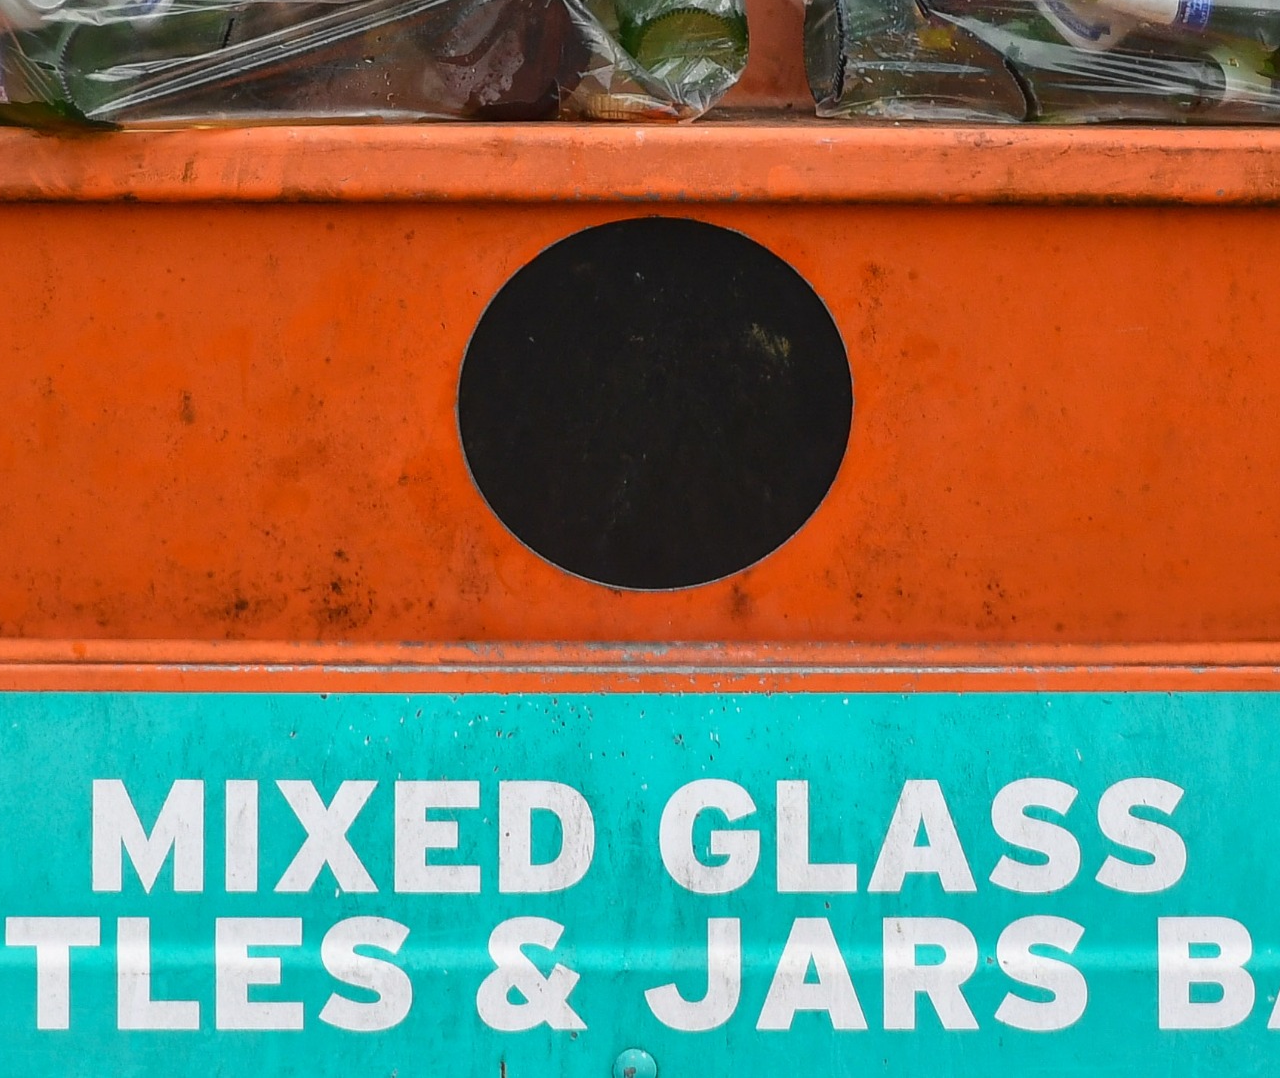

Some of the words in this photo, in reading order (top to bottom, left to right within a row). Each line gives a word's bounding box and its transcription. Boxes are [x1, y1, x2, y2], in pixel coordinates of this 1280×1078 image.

[92, 779, 595, 894] MIXED
[660, 777, 1187, 894] GLASS
[476, 915, 587, 1032] &
[645, 915, 1088, 1033] JARS
